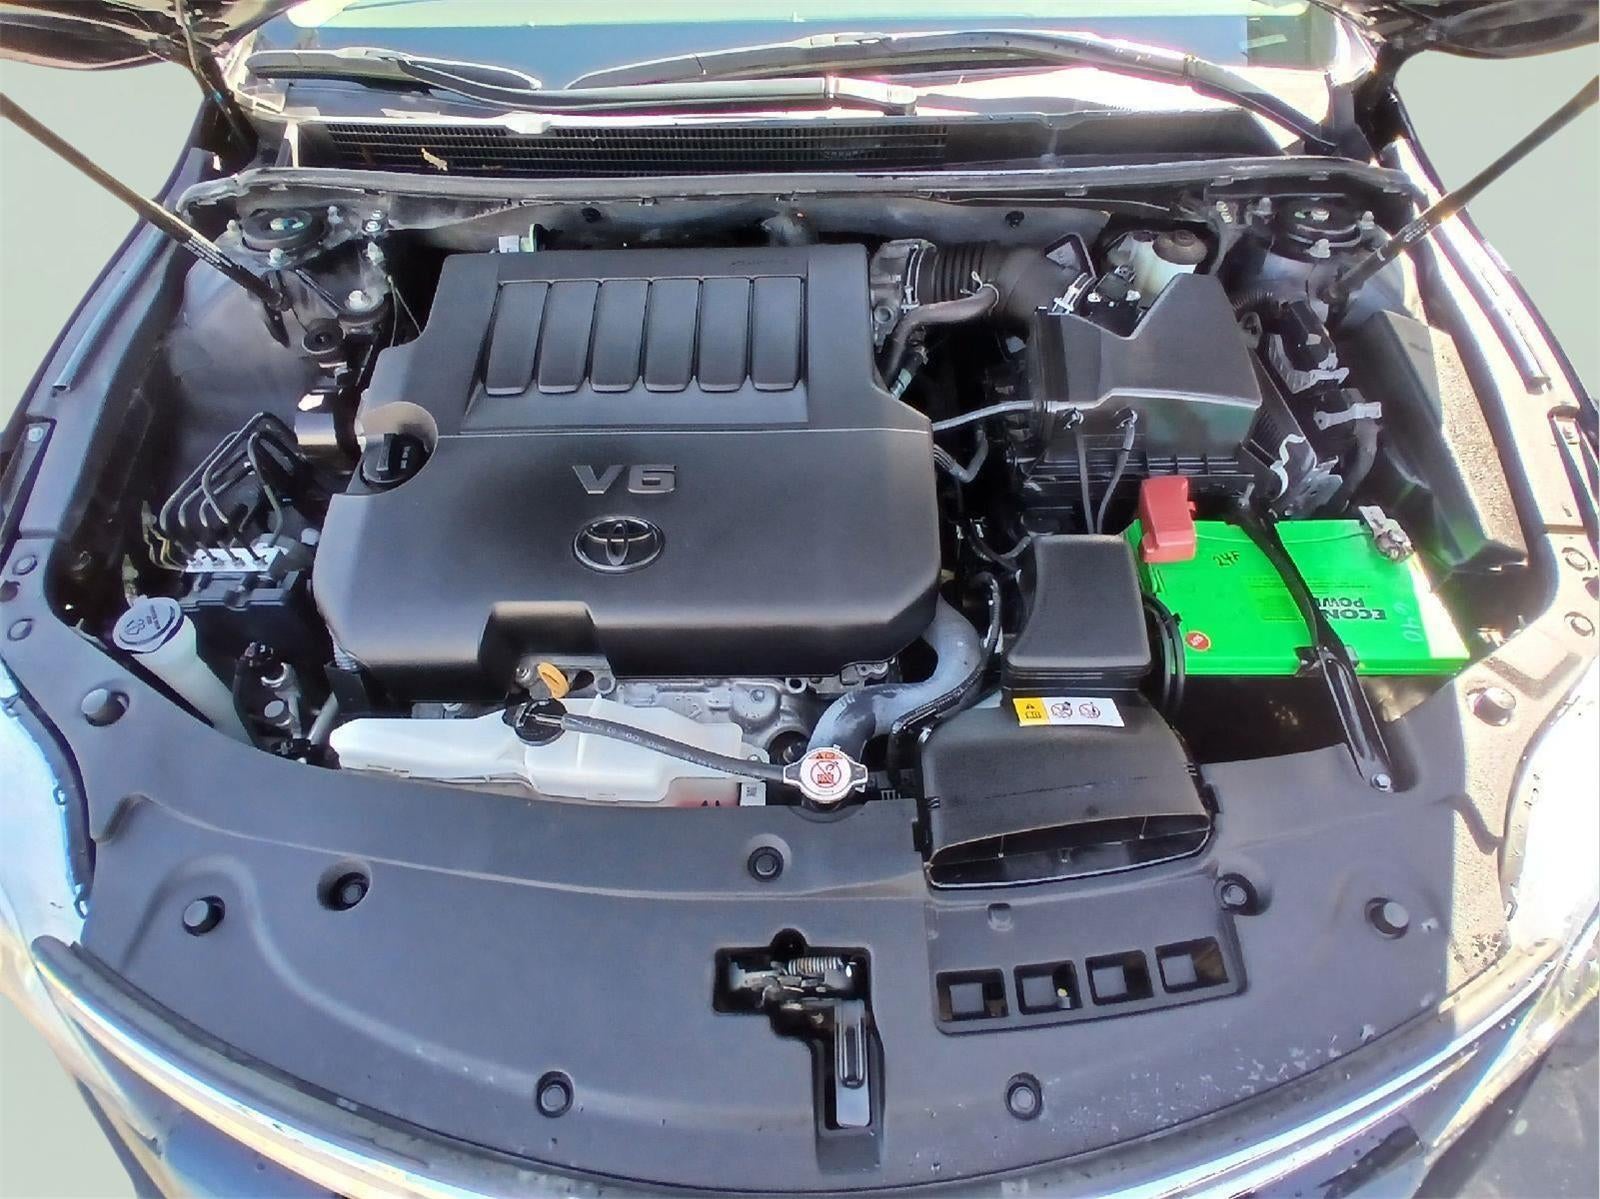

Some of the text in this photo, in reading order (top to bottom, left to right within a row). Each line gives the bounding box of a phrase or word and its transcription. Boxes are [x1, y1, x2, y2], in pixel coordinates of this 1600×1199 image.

[572, 464, 676, 494] V6
[1317, 597, 1365, 608] POW
[1321, 609, 1387, 620] ECON
